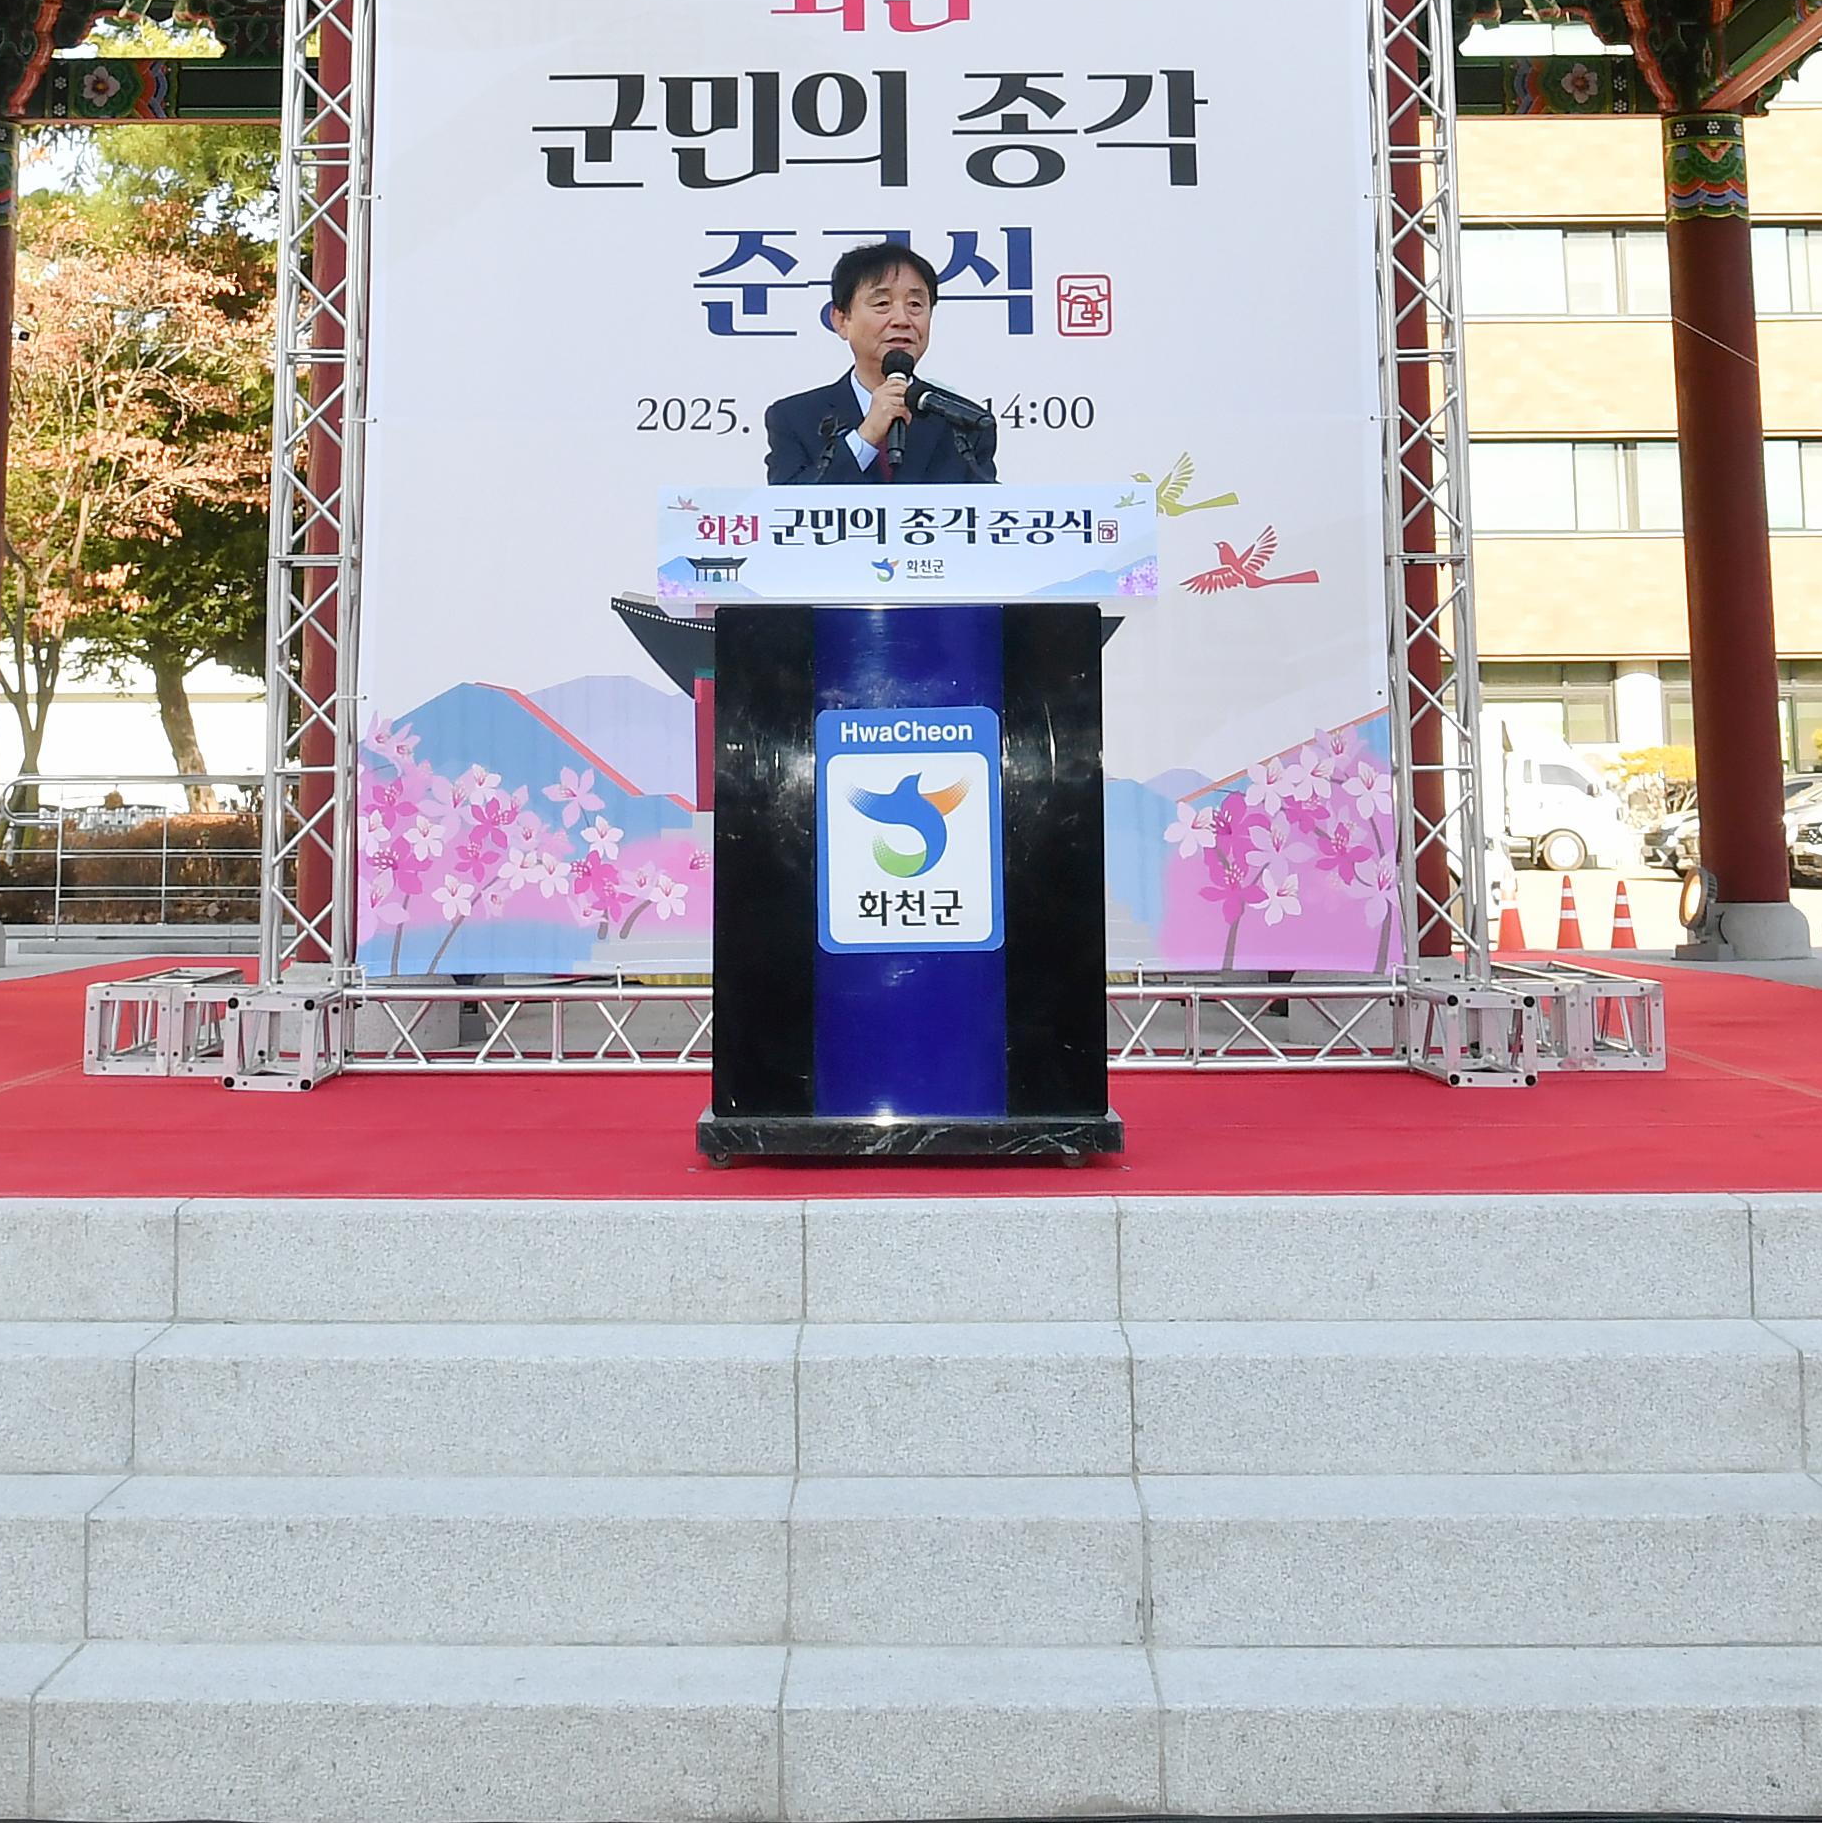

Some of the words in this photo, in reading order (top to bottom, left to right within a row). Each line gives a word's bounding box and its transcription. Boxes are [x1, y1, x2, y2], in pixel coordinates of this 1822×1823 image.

[532, 71, 908, 188] 군민의
[952, 70, 1208, 188] 종각
[637, 398, 749, 434] 2025.
[696, 513, 759, 546] 화천
[769, 508, 886, 545] 군민의
[900, 507, 979, 545] 종각
[987, 510, 1092, 545] 준공식
[841, 721, 972, 742] HwaCheon
[859, 890, 963, 926] 화천군
